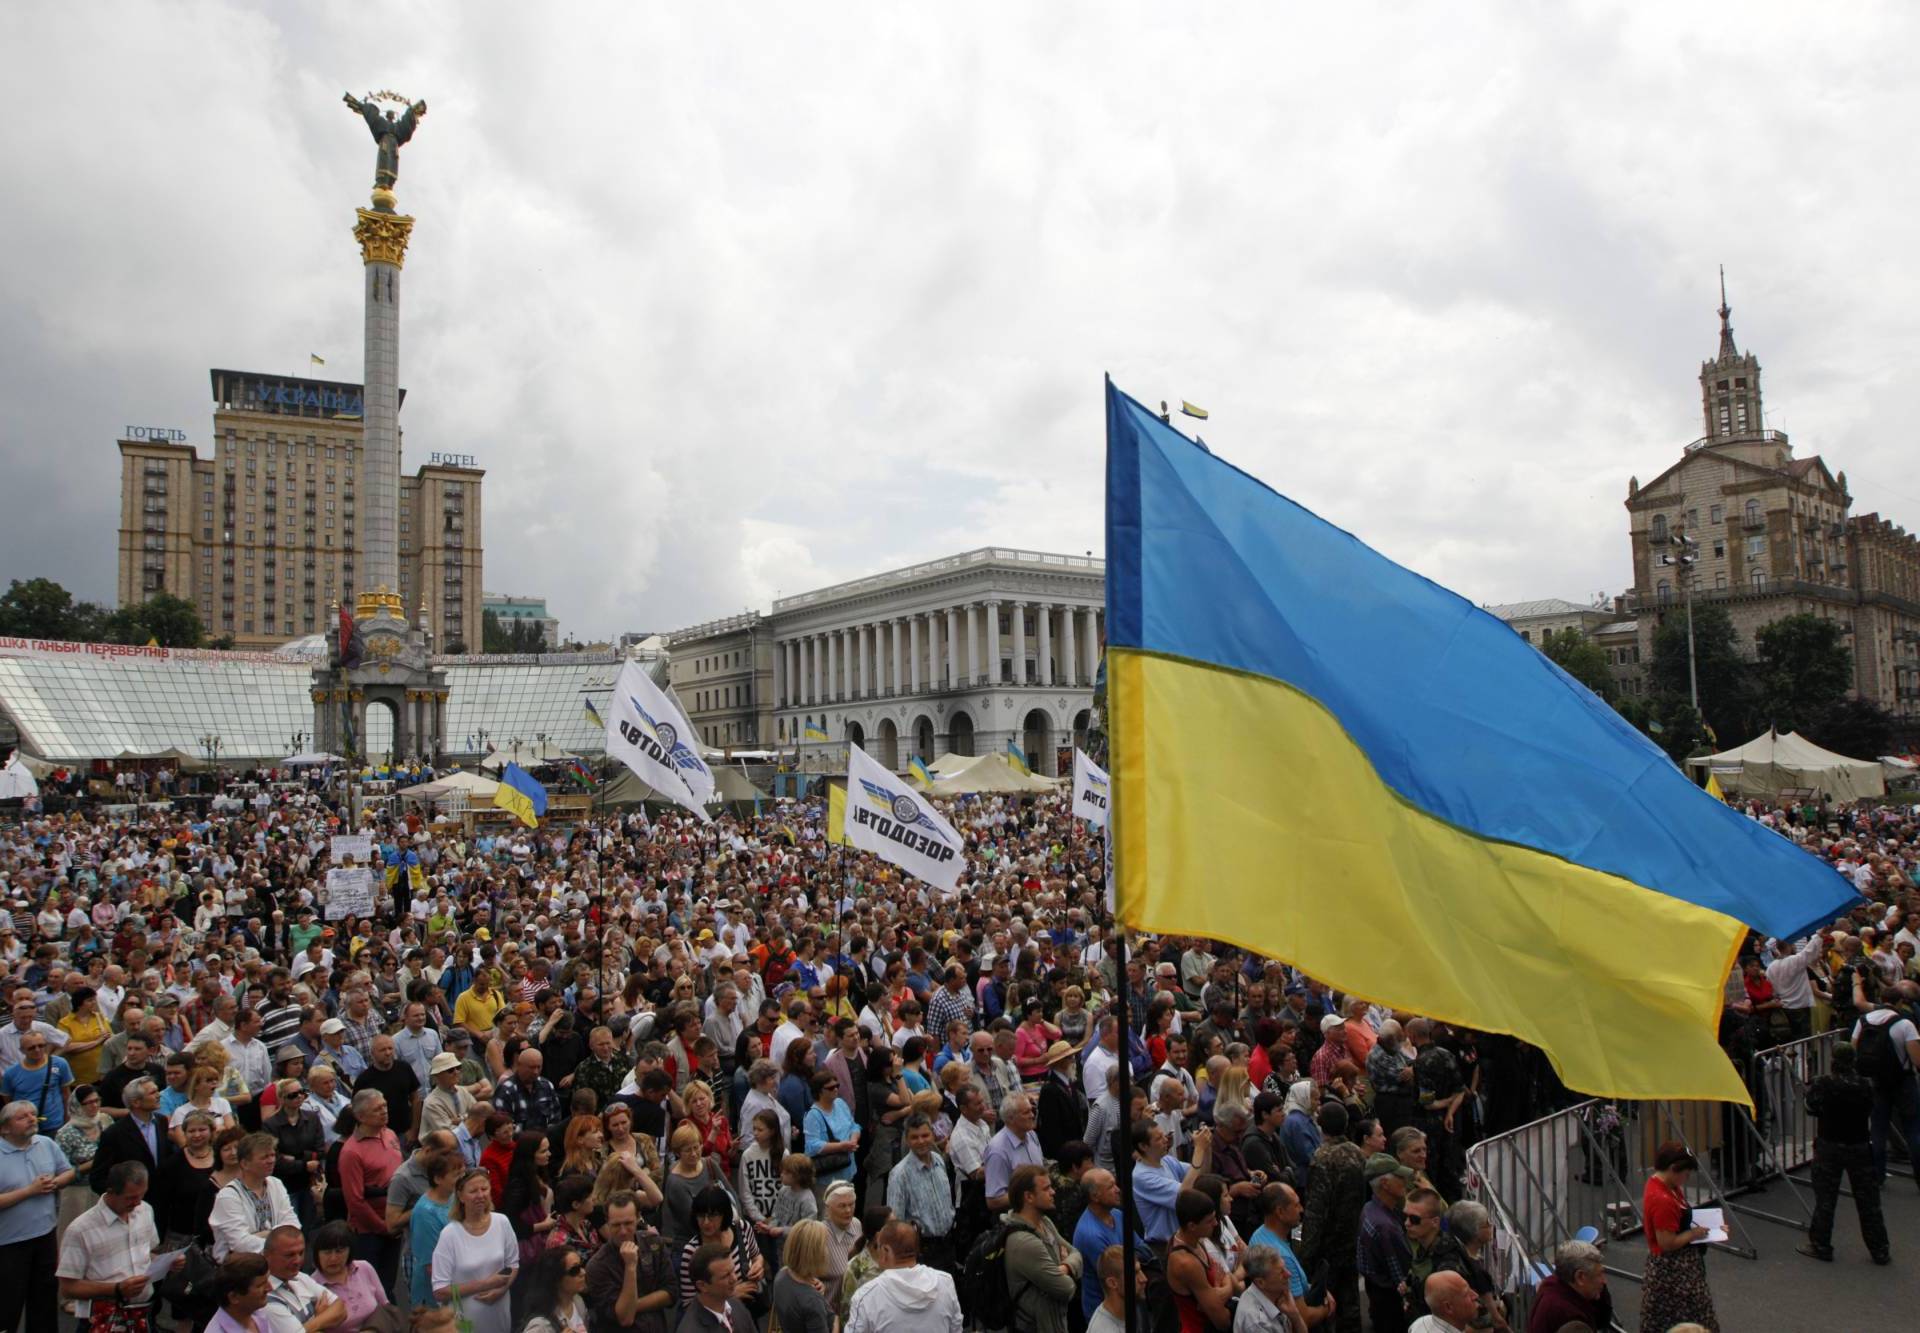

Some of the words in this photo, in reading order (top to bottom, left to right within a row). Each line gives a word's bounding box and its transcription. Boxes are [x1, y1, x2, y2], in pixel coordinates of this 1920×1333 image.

[256, 384, 364, 411] УКРАЇНА
[126, 425, 187, 441] ГОТЕЛЬ
[431, 452, 478, 466] HOTEL
[32, 640, 81, 653] ГАНЬБИ
[85, 643, 169, 658] ПЕРЕВЕРТНІВ
